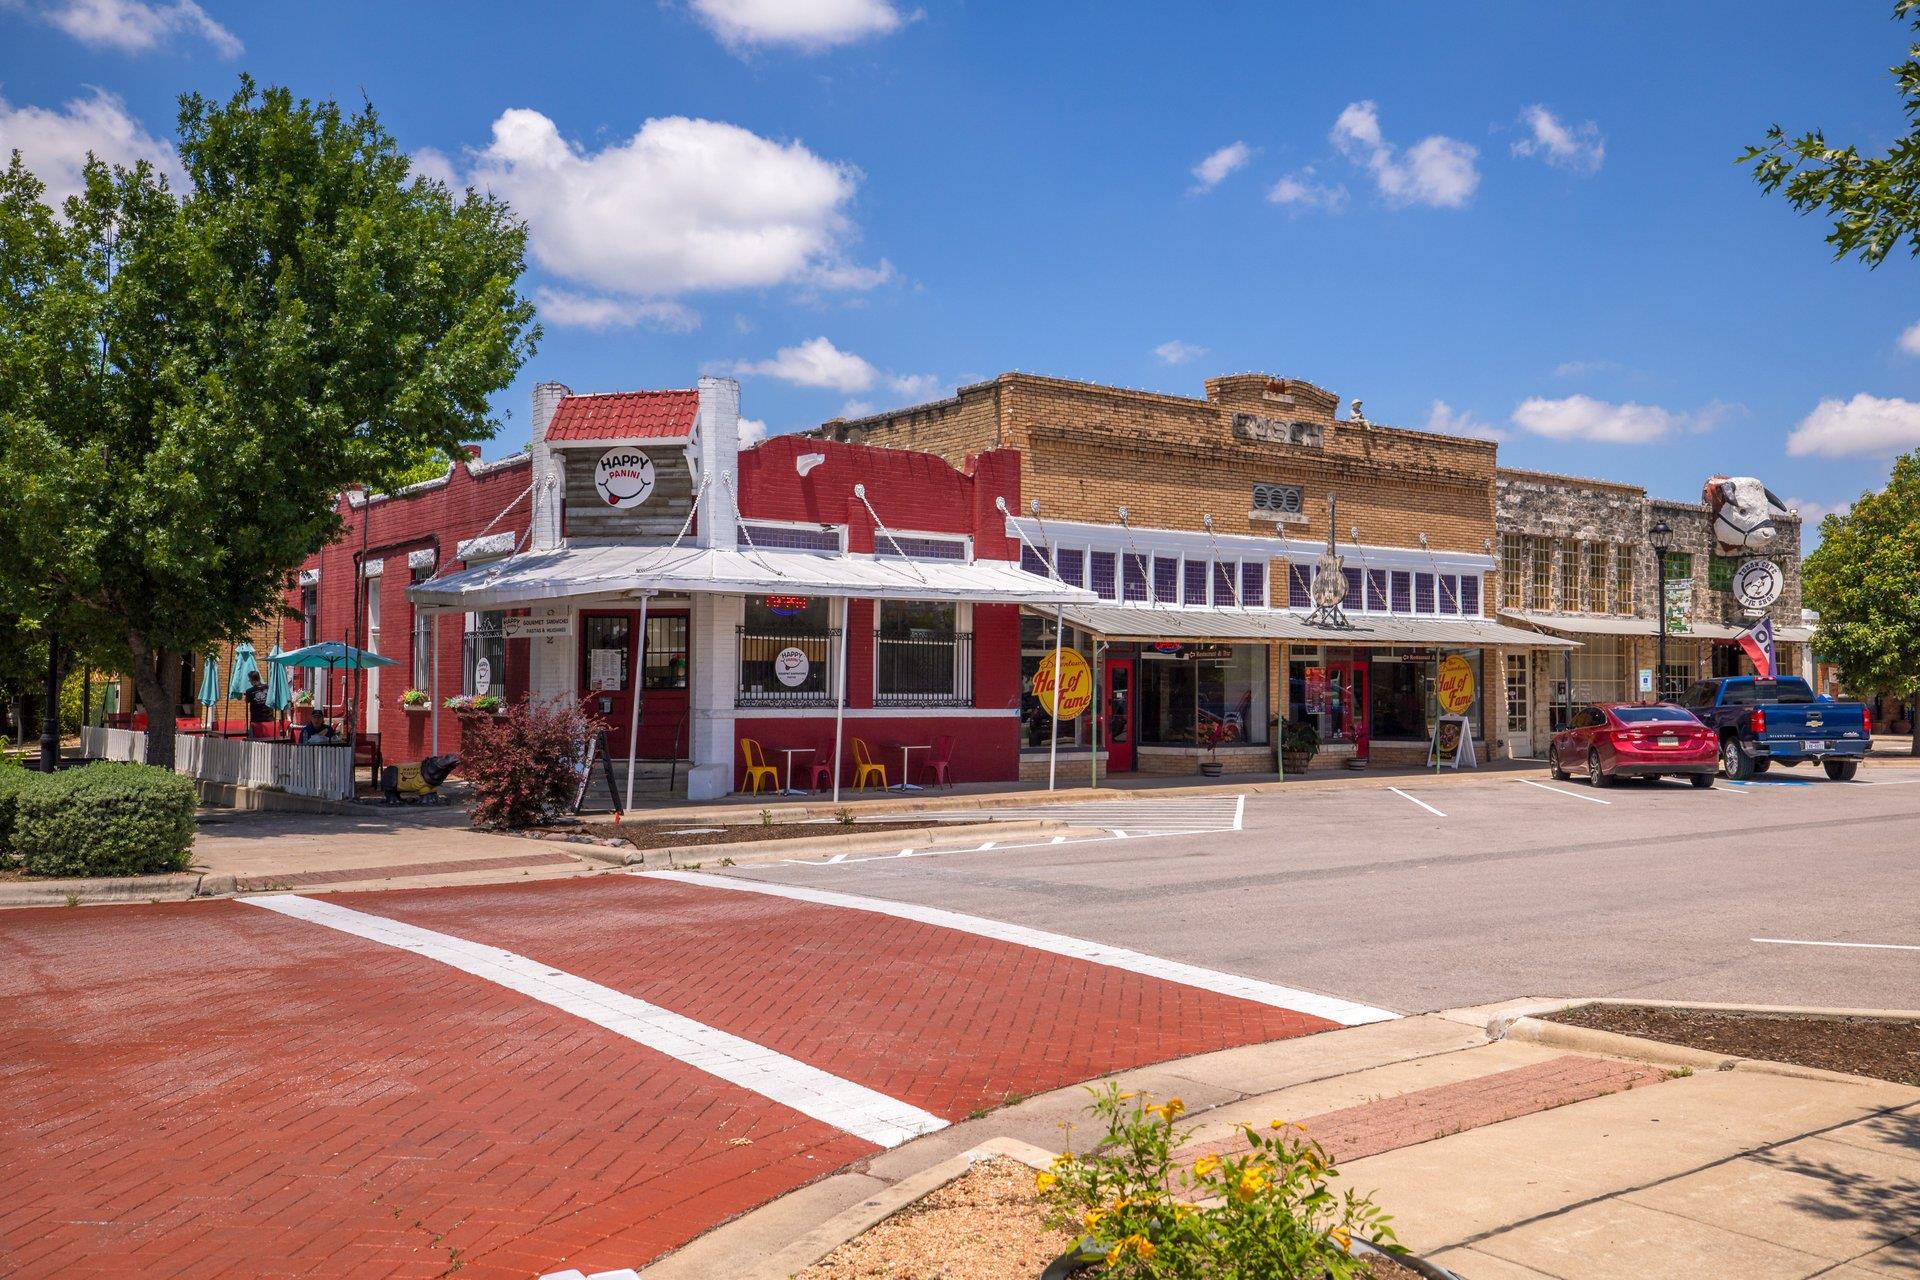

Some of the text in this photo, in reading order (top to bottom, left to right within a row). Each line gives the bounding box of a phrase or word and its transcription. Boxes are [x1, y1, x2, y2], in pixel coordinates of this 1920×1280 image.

[600, 454, 650, 471] HAPPY
[608, 469, 641, 479] PANINI
[1761, 561, 1778, 575] CAFE
[1744, 598, 1756, 607] PIE
[1758, 593, 1775, 606] SHOP
[781, 650, 803, 659] HAPPY
[1067, 670, 1084, 692] of
[1457, 673, 1469, 692] of
[1057, 688, 1091, 710] Fame
[1448, 689, 1473, 708] Fame
